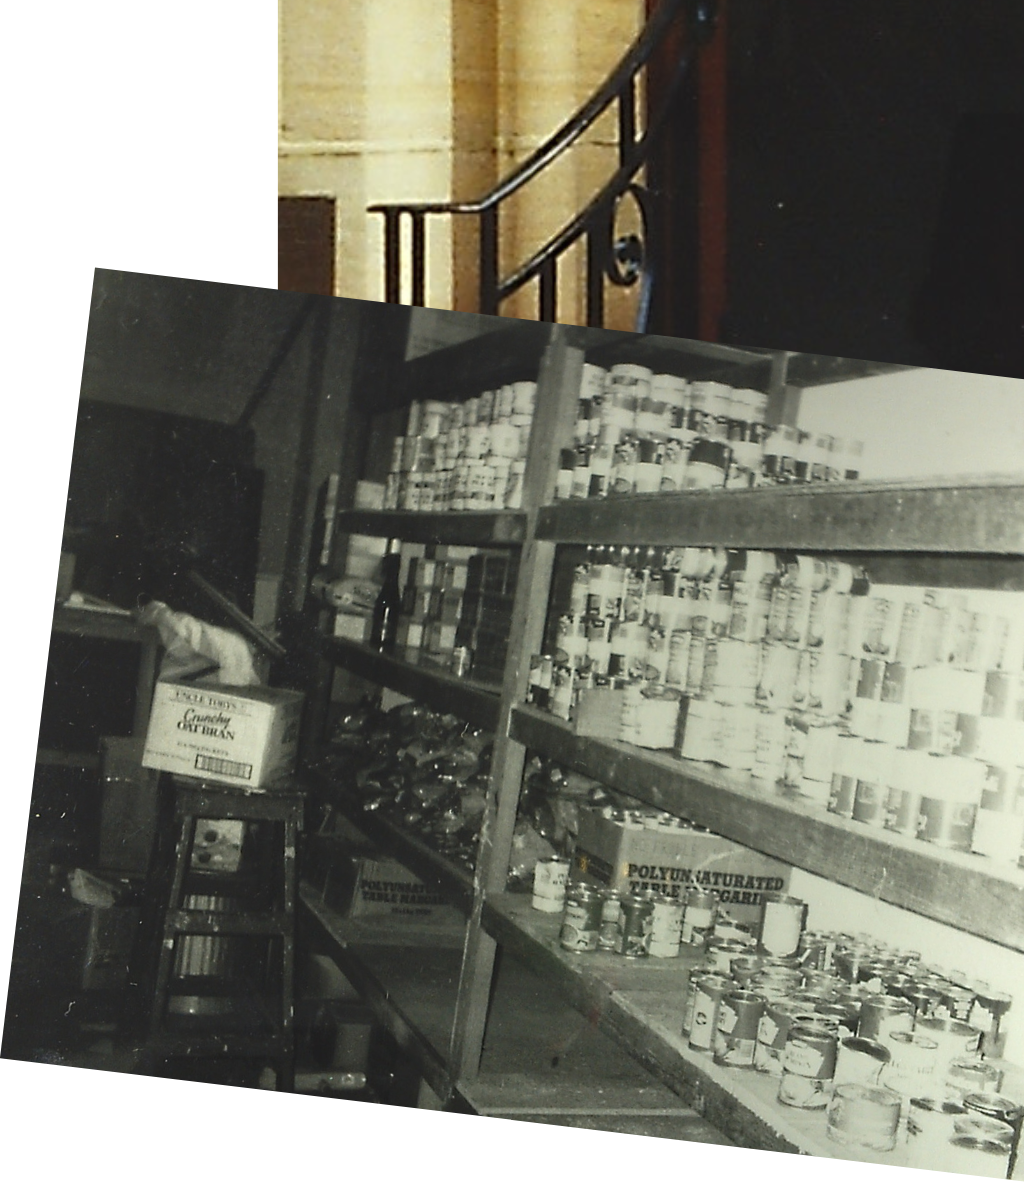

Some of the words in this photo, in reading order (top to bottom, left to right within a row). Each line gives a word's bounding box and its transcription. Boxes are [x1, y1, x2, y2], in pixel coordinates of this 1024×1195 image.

[184, 708, 231, 729] Crunchy
[177, 722, 200, 733] OAT
[201, 725, 234, 740] BRAN
